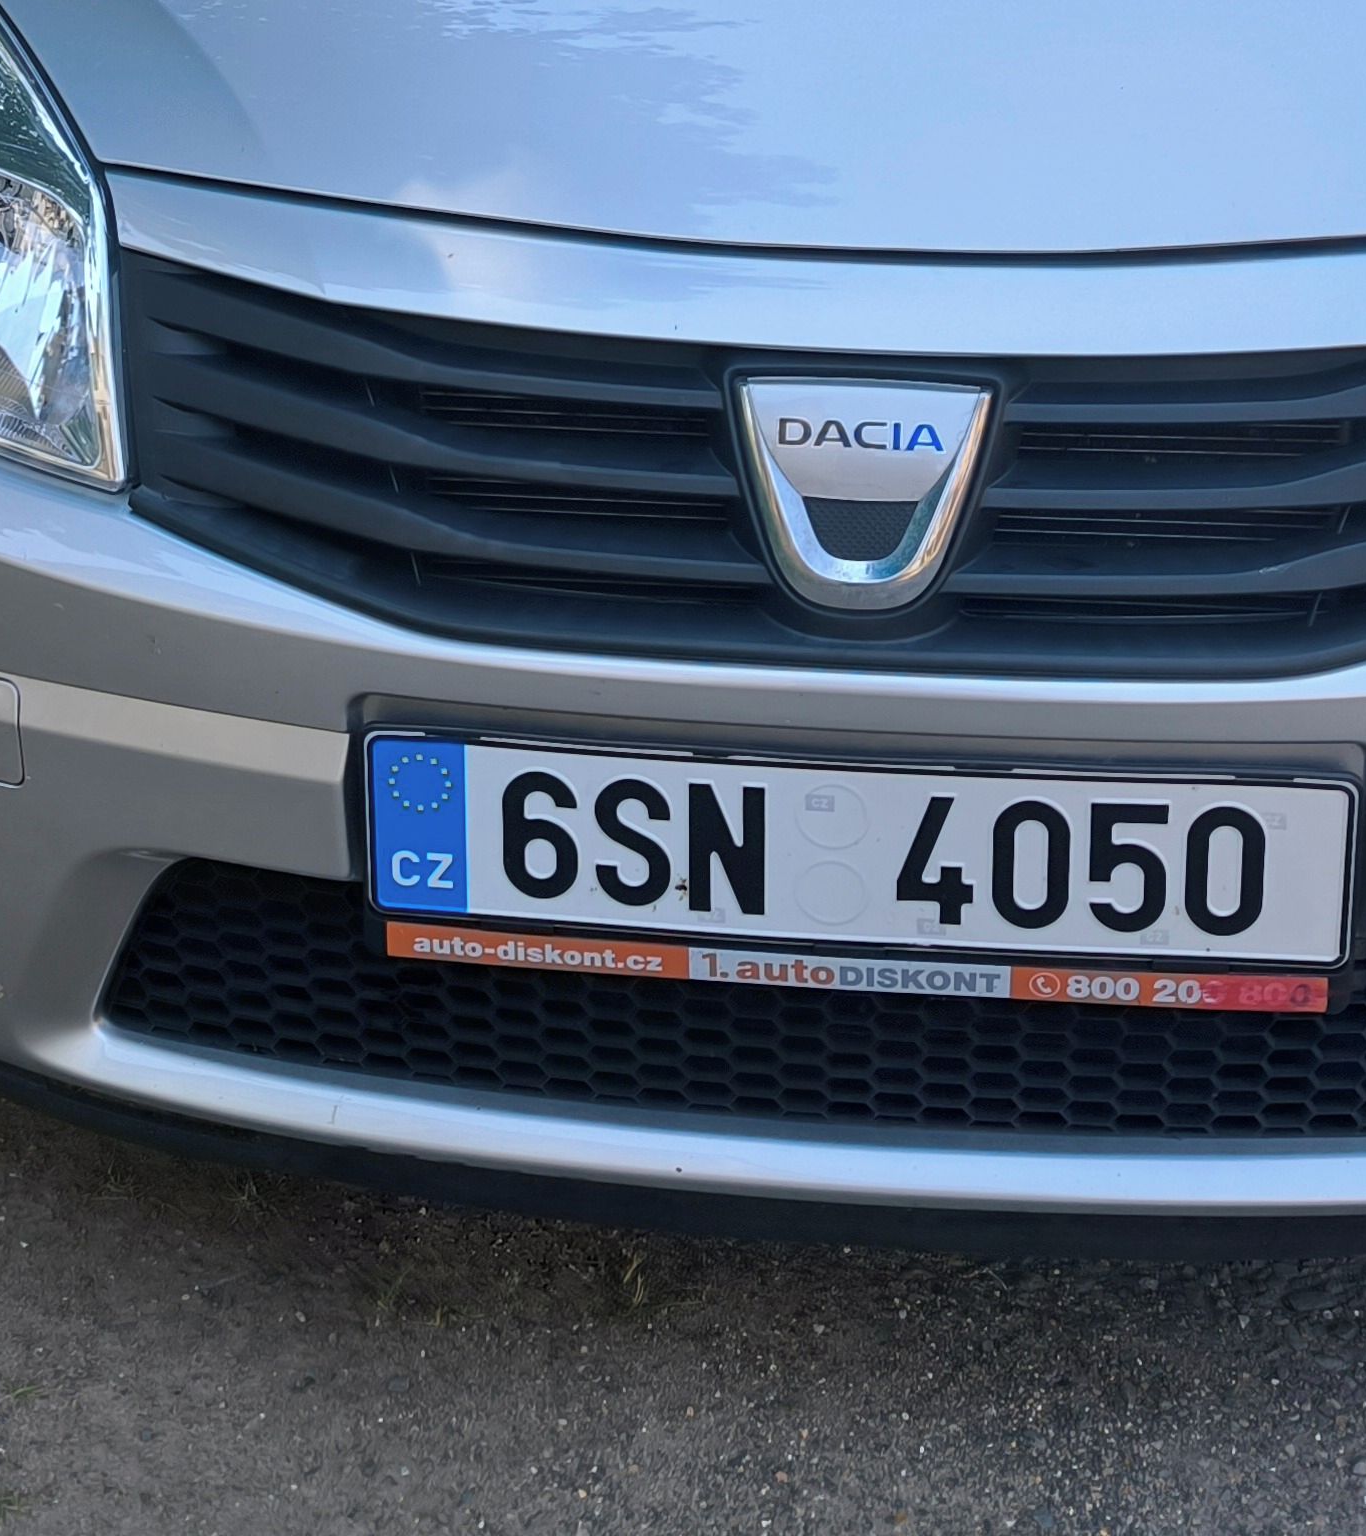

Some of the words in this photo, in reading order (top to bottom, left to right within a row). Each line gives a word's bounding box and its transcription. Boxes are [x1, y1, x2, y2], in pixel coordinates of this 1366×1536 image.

[778, 417, 945, 452] DACIA
[390, 849, 455, 889] CZ
[501, 770, 767, 916] 6SN
[895, 795, 1267, 938] 4050
[413, 936, 664, 972] auto-diskont.cz
[1065, 974, 1141, 1001] 800
